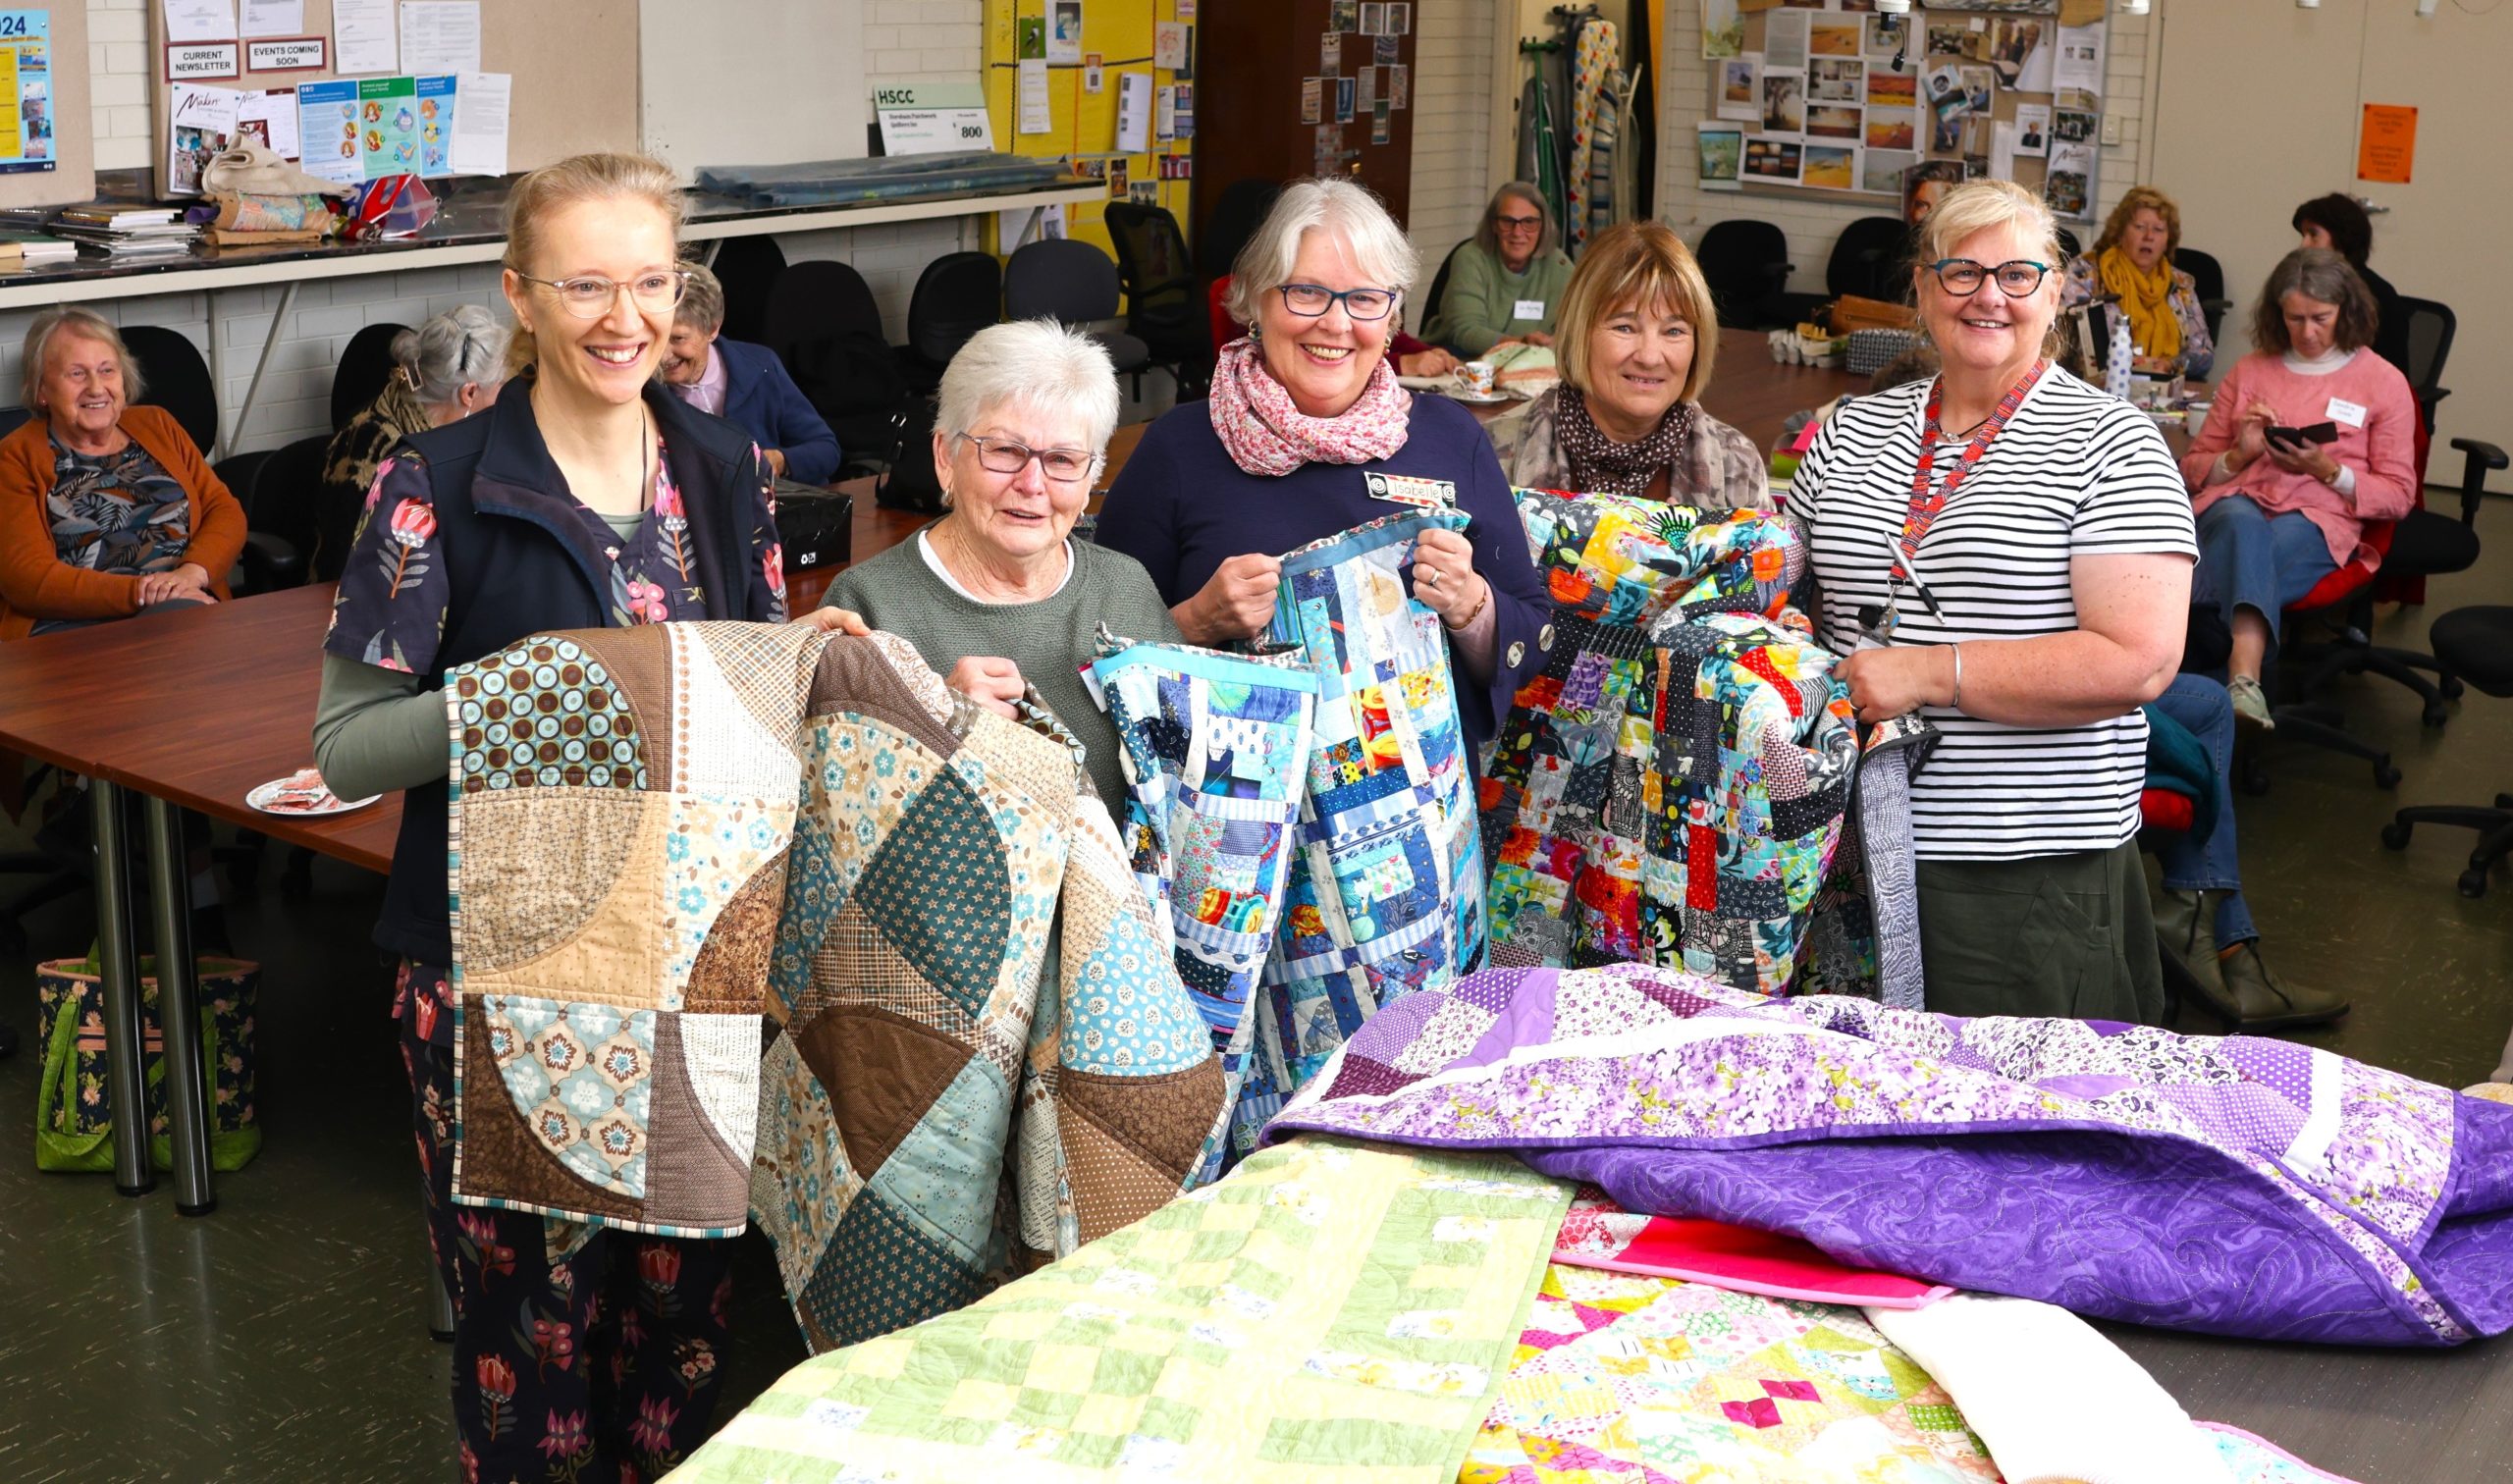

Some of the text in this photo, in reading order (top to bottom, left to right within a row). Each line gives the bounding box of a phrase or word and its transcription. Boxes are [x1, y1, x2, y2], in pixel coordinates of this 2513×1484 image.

[0, 16, 27, 35] 24
[183, 51, 223, 61] CURRENT
[253, 45, 319, 56] EVENTS COMING
[176, 62, 231, 72] NEWSLETTER
[276, 57, 299, 66] SOON
[878, 89, 915, 104] HSCC
[961, 127, 983, 138] 800
[1394, 483, 1439, 499] Isabelle
